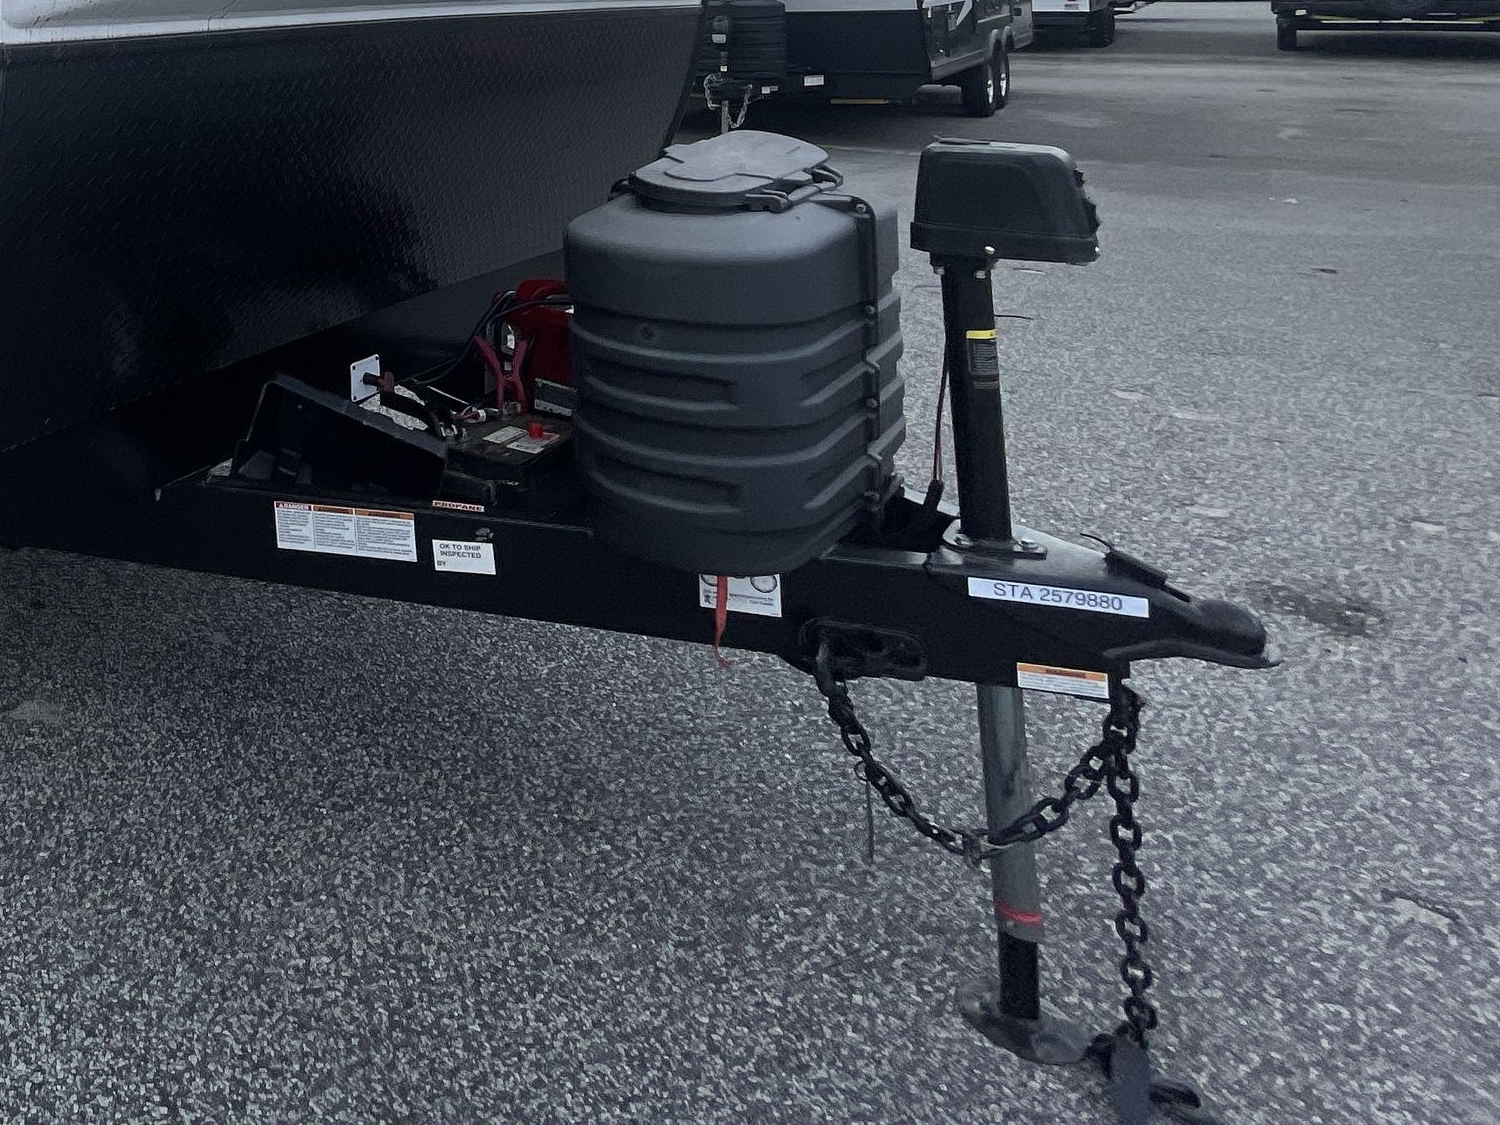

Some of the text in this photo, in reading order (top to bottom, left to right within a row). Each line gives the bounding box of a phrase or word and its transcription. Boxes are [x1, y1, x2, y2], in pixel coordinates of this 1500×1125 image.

[434, 501, 483, 511] PROPANE
[440, 550, 482, 559] INSPECTED
[993, 582, 1123, 611] STA 2579880
